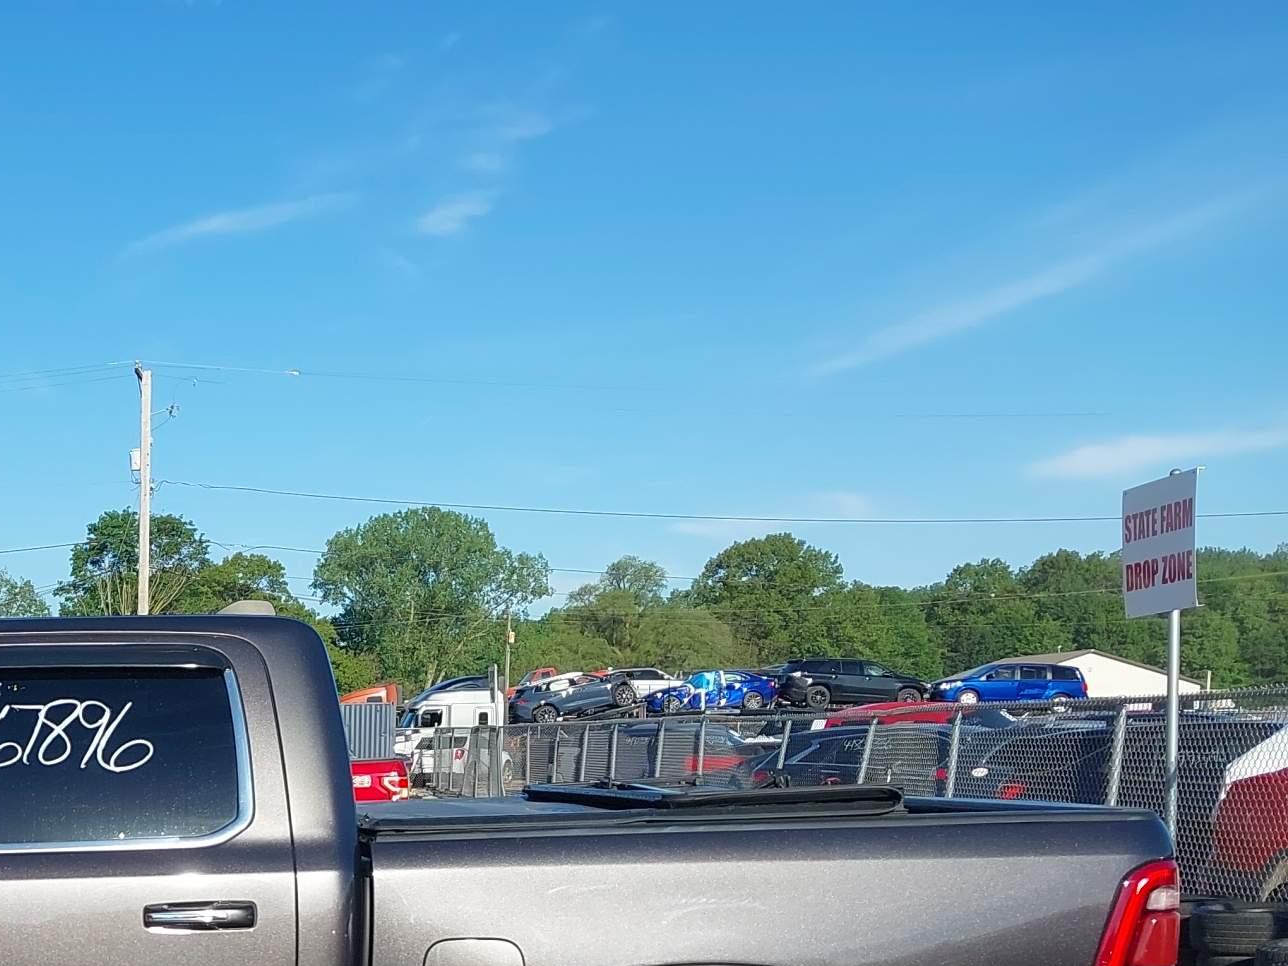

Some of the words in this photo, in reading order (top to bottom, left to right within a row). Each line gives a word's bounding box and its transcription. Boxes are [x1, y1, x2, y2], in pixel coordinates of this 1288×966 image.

[1124, 506, 1158, 544] STATE
[1160, 498, 1193, 534] FARM
[1125, 558, 1159, 592] DROP
[1161, 550, 1193, 585] ZONE
